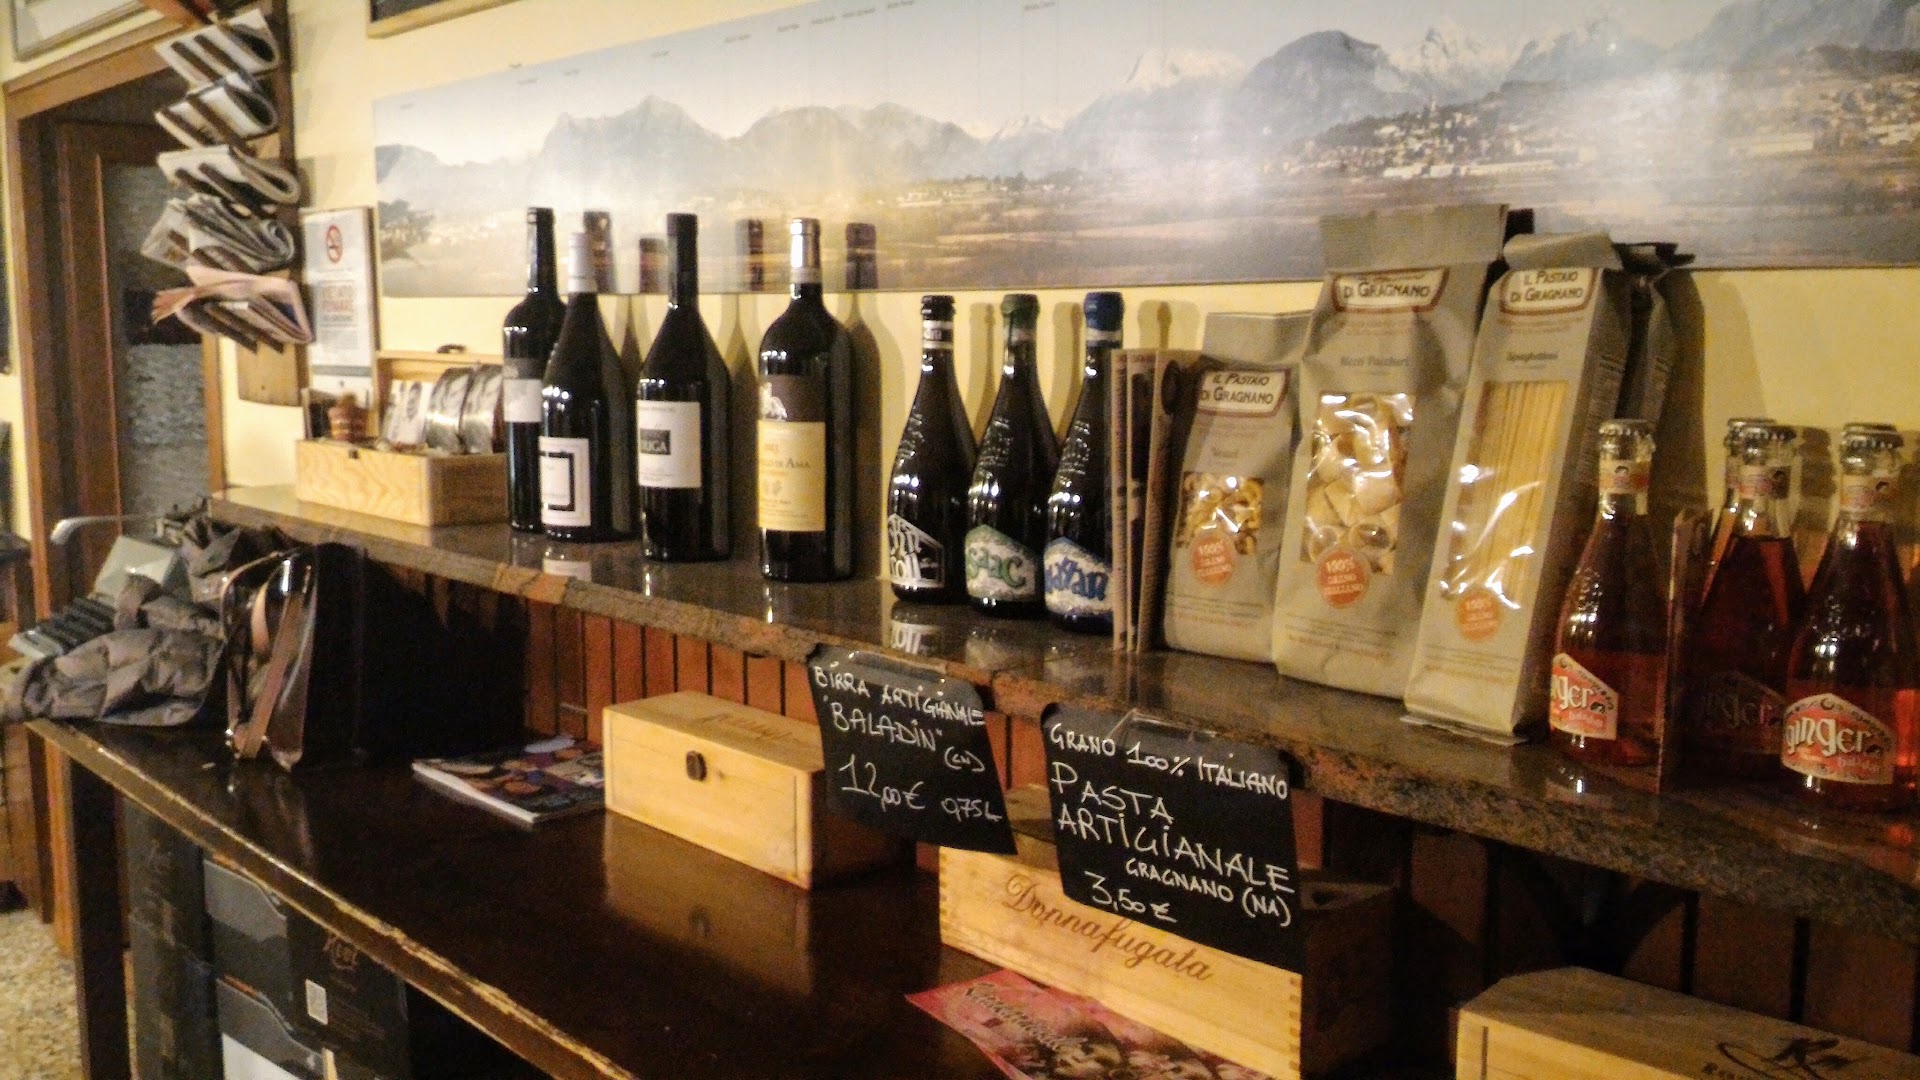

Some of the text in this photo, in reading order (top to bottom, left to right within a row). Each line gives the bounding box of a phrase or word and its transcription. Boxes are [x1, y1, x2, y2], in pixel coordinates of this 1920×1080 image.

[1358, 281, 1430, 298] GRAGNANO
[1525, 287, 1584, 302] GRAGNANO
[1213, 386, 1274, 405] GRAGNANO
[814, 666, 871, 698] BIRRA
[1050, 722, 1288, 801] GRANO 100% ITALIANO
[1785, 716, 1872, 758] ginger
[1050, 761, 1175, 825] PASTA
[1058, 803, 1296, 894] ARTIGIANALE
[1125, 857, 1292, 928] GRAGNANO (NA)
[1002, 874, 1213, 981] Donnafugata
